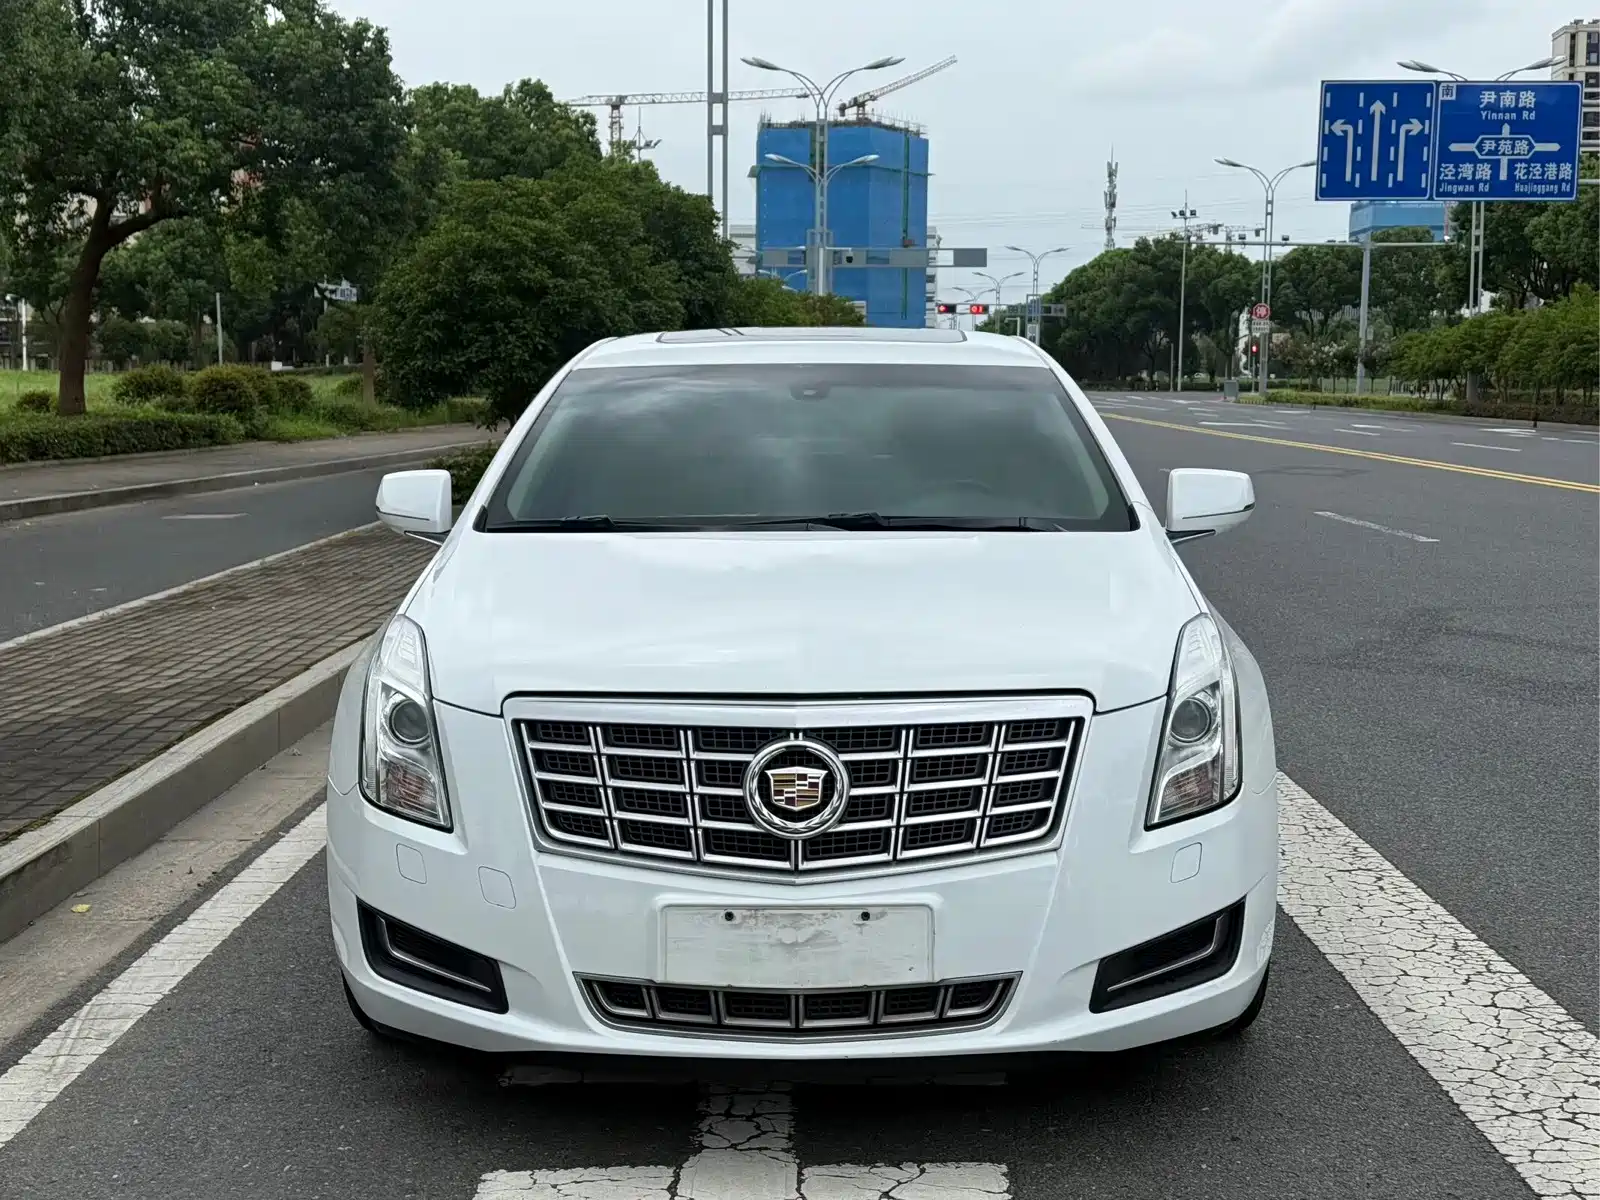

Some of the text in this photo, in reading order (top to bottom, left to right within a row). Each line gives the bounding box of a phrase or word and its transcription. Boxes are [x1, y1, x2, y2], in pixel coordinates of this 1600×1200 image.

[1441, 84, 1454, 99] 南
[1480, 90, 1536, 108] 尹南路
[1481, 110, 1536, 120] Yinnan Rd
[1481, 139, 1530, 154] 尹苑路
[1440, 163, 1492, 180] 泾湾路
[1514, 162, 1572, 180] 花泾港路
[1440, 183, 1489, 194] Jingwan Rd
[1515, 182, 1570, 194] Huajinggang Rd
